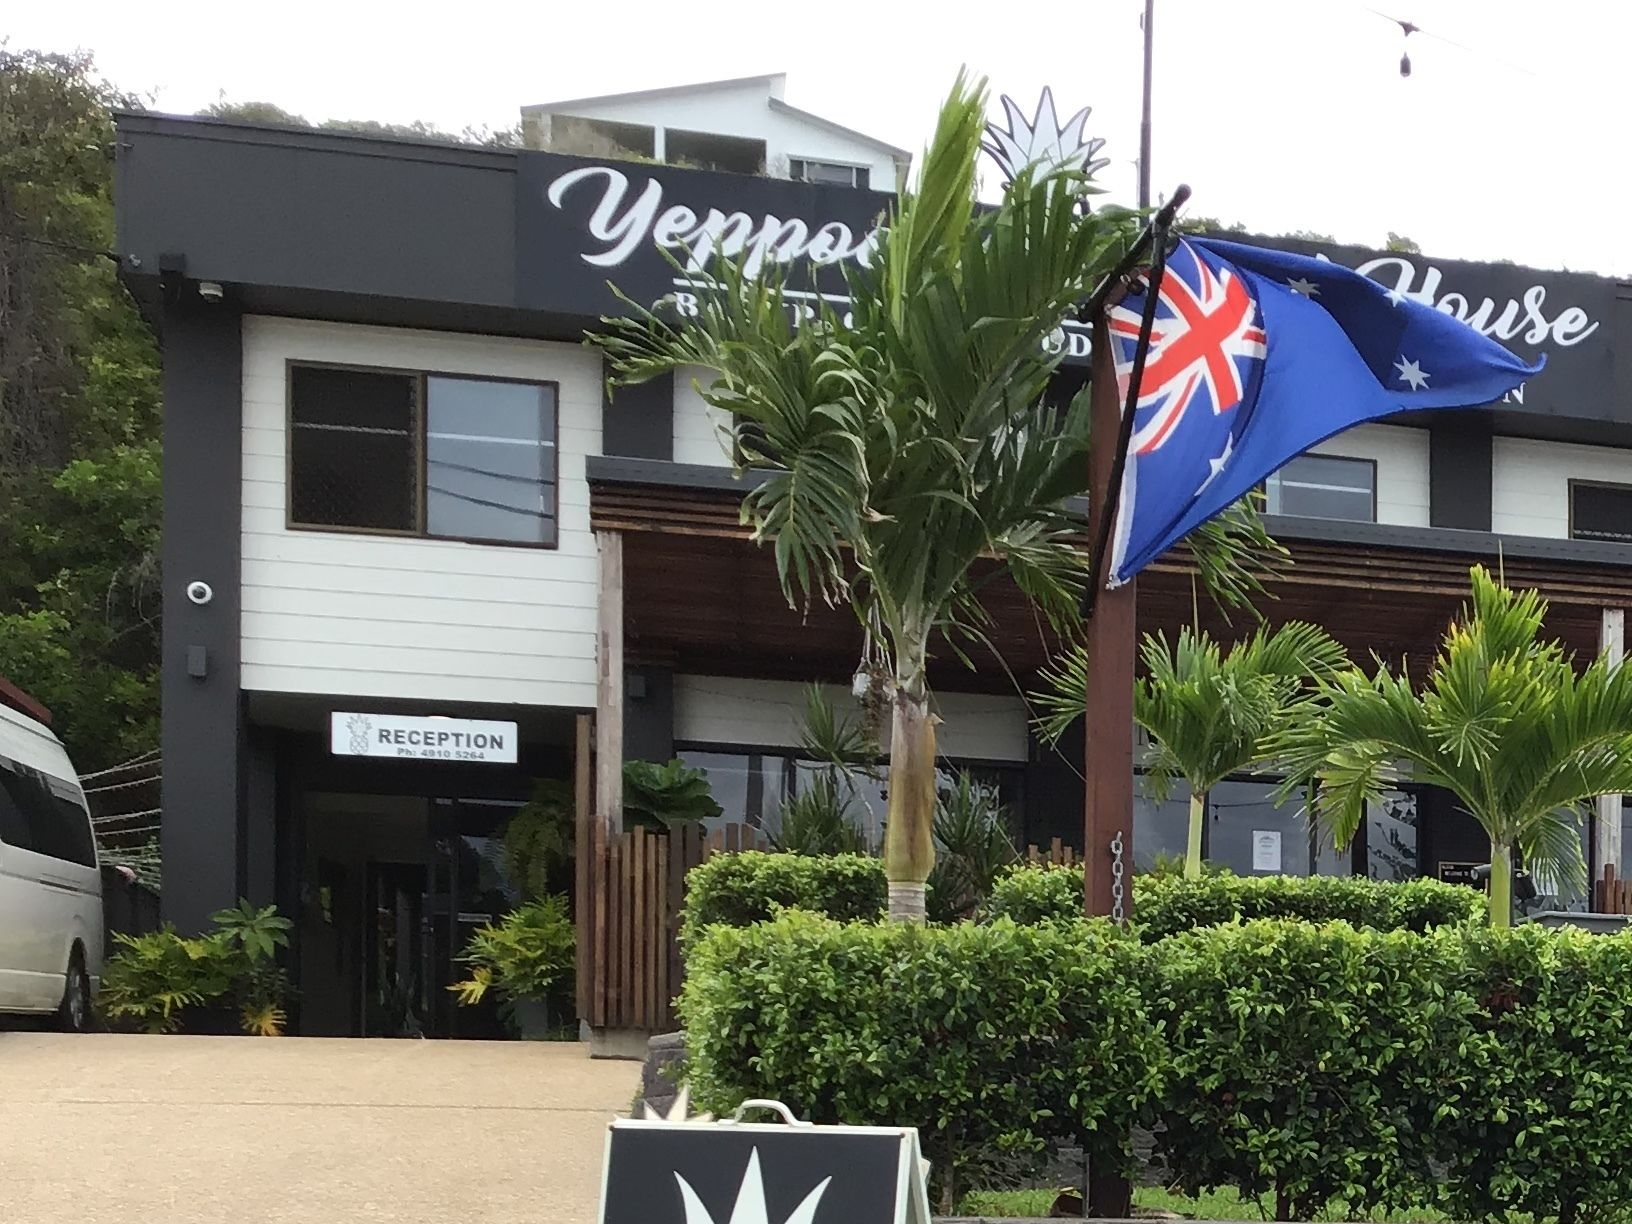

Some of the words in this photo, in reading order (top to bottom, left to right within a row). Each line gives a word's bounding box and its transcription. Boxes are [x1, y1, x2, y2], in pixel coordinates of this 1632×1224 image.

[378, 728, 504, 750] RECEPTION
[420, 748, 452, 759] 4910
[454, 750, 485, 760] 5264
